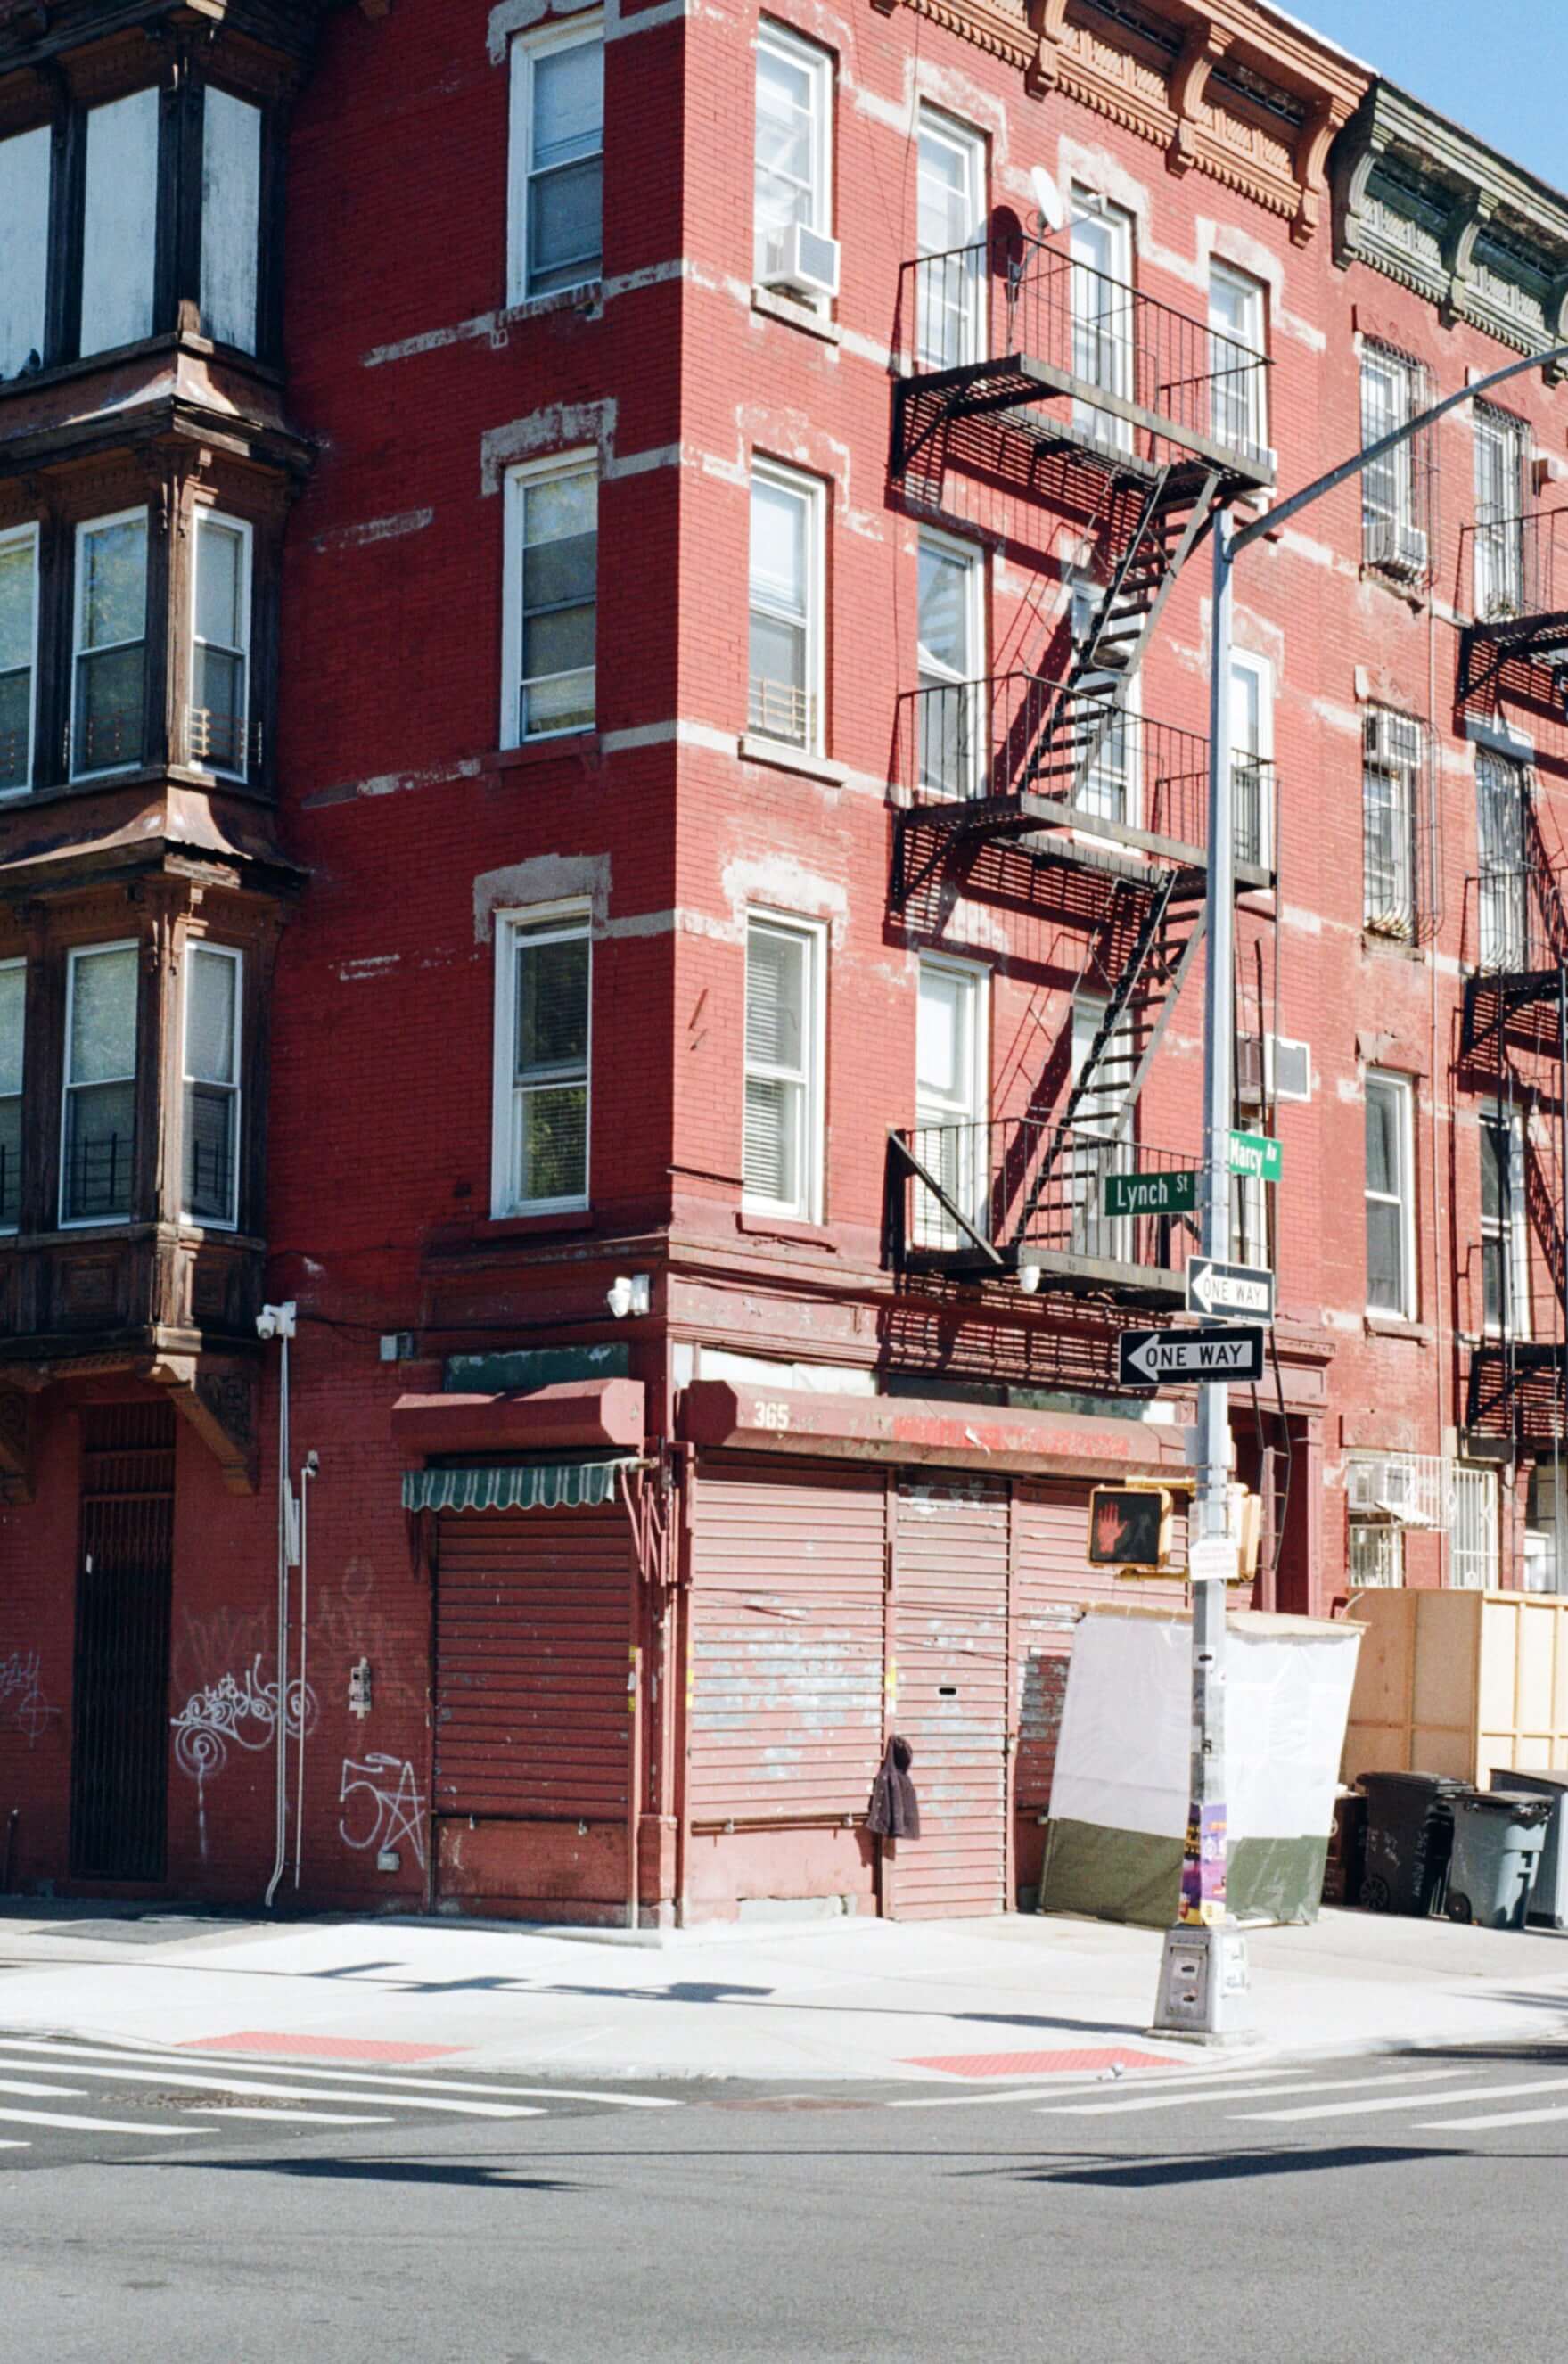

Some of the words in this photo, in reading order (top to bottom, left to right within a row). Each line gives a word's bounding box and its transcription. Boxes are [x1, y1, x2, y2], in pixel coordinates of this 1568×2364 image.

[1117, 1178, 1168, 1212] Lynch
[1177, 1176, 1188, 1192] St
[1203, 1277, 1228, 1301] ONE
[1236, 1283, 1262, 1306] WAY
[1145, 1346, 1186, 1367] ONE
[1199, 1343, 1243, 1366] WAY
[754, 1400, 789, 1431] 365
